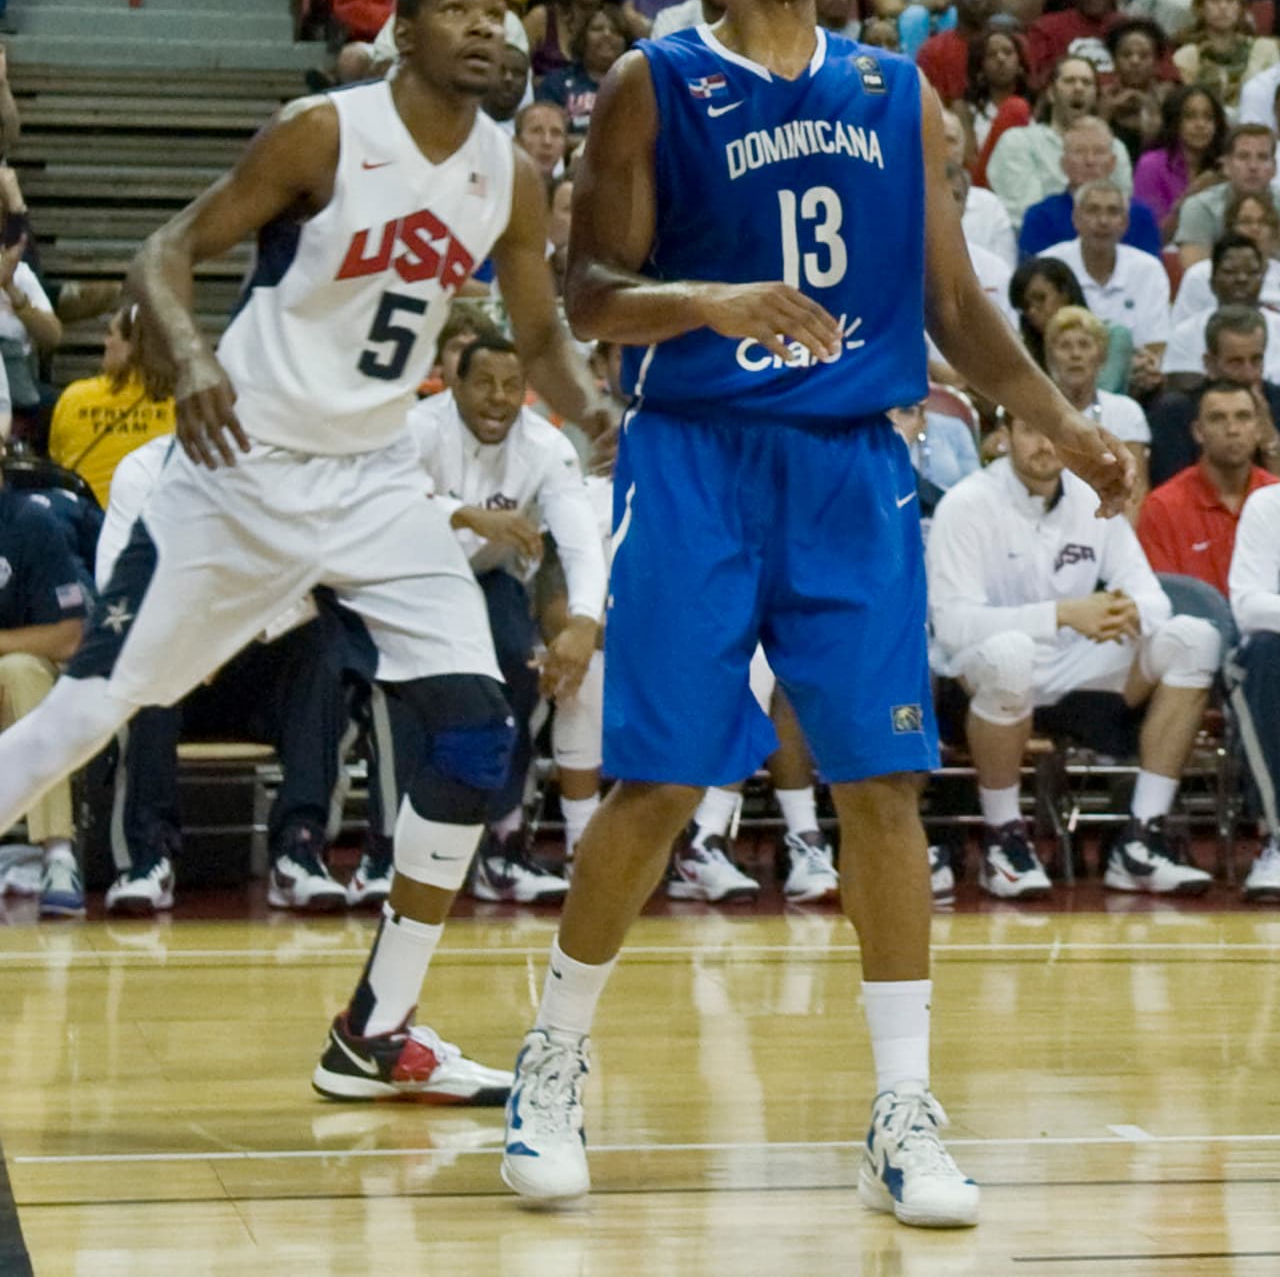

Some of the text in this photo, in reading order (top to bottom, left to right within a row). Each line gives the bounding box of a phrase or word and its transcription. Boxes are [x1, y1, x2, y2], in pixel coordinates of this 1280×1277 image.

[726, 119, 885, 181] DOMINICANA
[334, 208, 475, 293] USA
[777, 185, 848, 290] 13
[356, 289, 430, 381] 5
